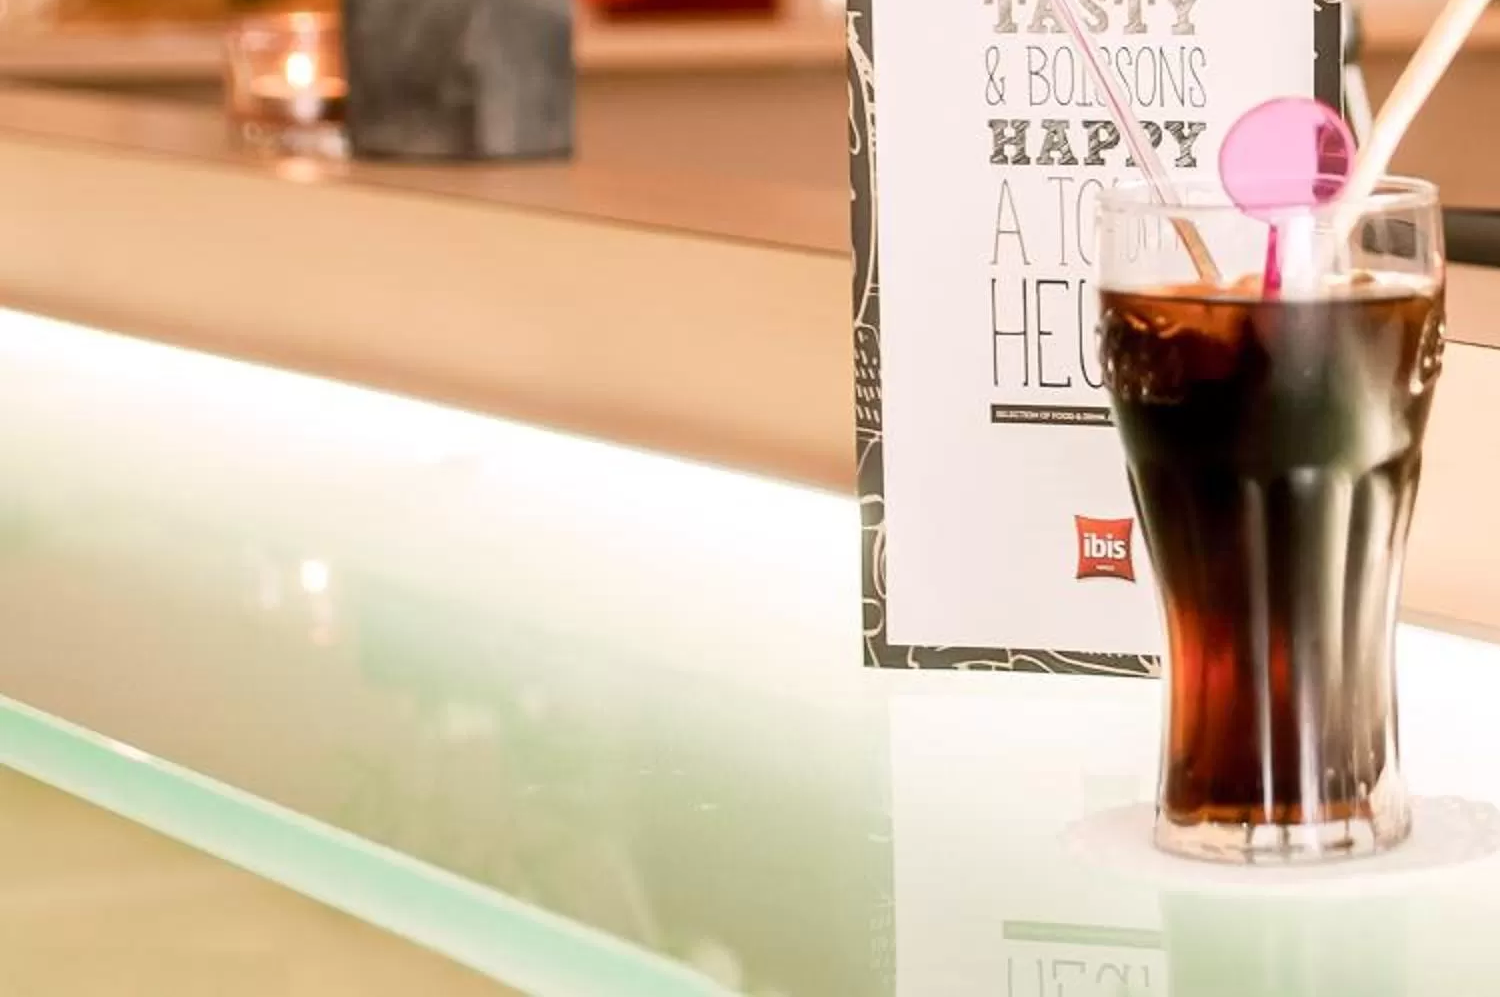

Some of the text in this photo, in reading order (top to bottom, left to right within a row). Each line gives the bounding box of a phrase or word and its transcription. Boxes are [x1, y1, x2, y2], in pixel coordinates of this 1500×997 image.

[985, 46, 1006, 106] &
[988, 119, 1207, 168] HAPPY
[990, 178, 1031, 265] A
[1083, 532, 1127, 560] ibis
